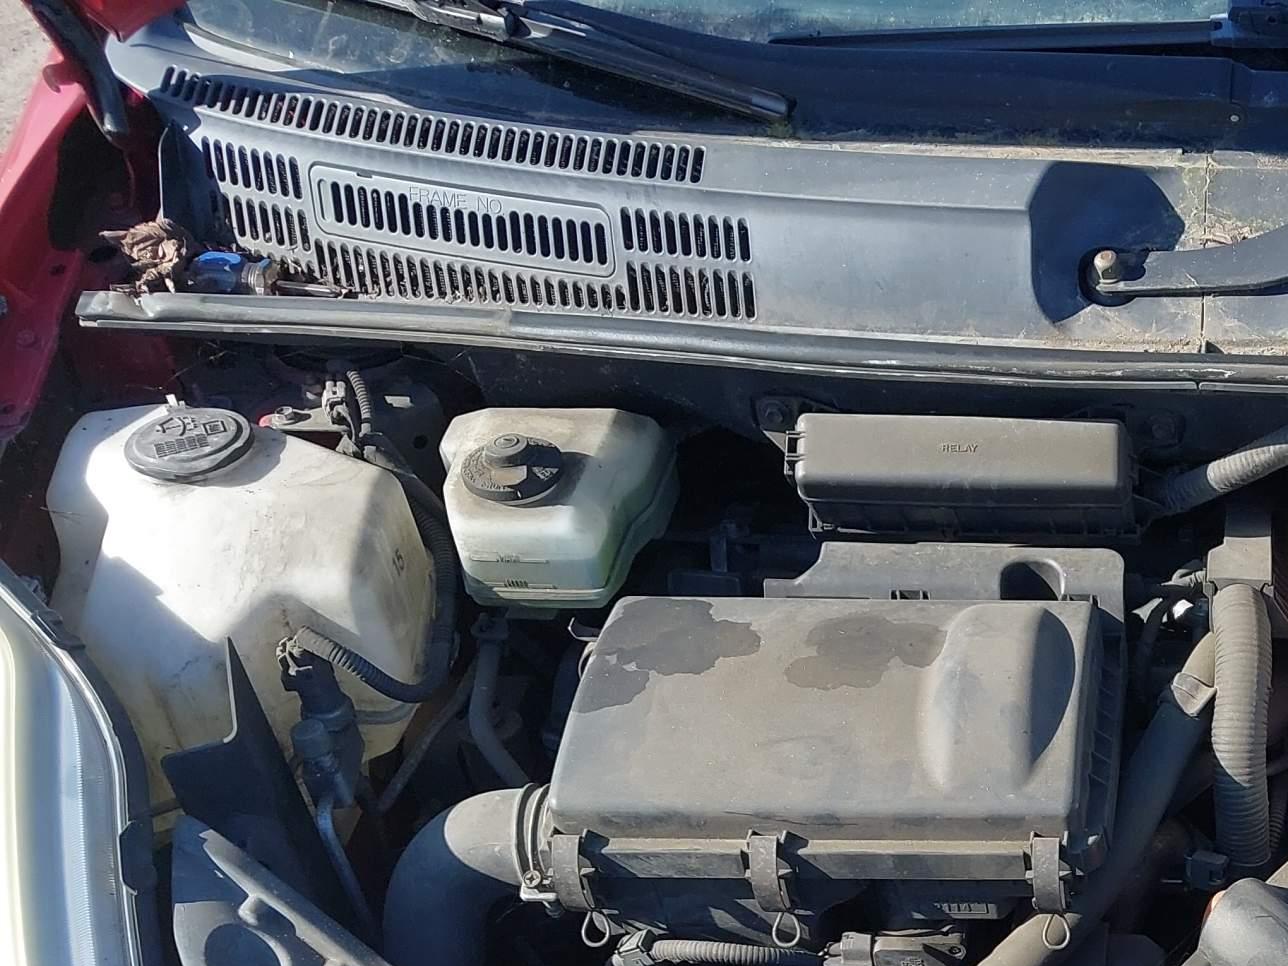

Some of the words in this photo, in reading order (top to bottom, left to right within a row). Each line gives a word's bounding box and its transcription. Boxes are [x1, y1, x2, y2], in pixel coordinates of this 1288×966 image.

[409, 186, 467, 210] FRAME
[477, 197, 505, 216] NO.
[942, 443, 979, 453] RELAY
